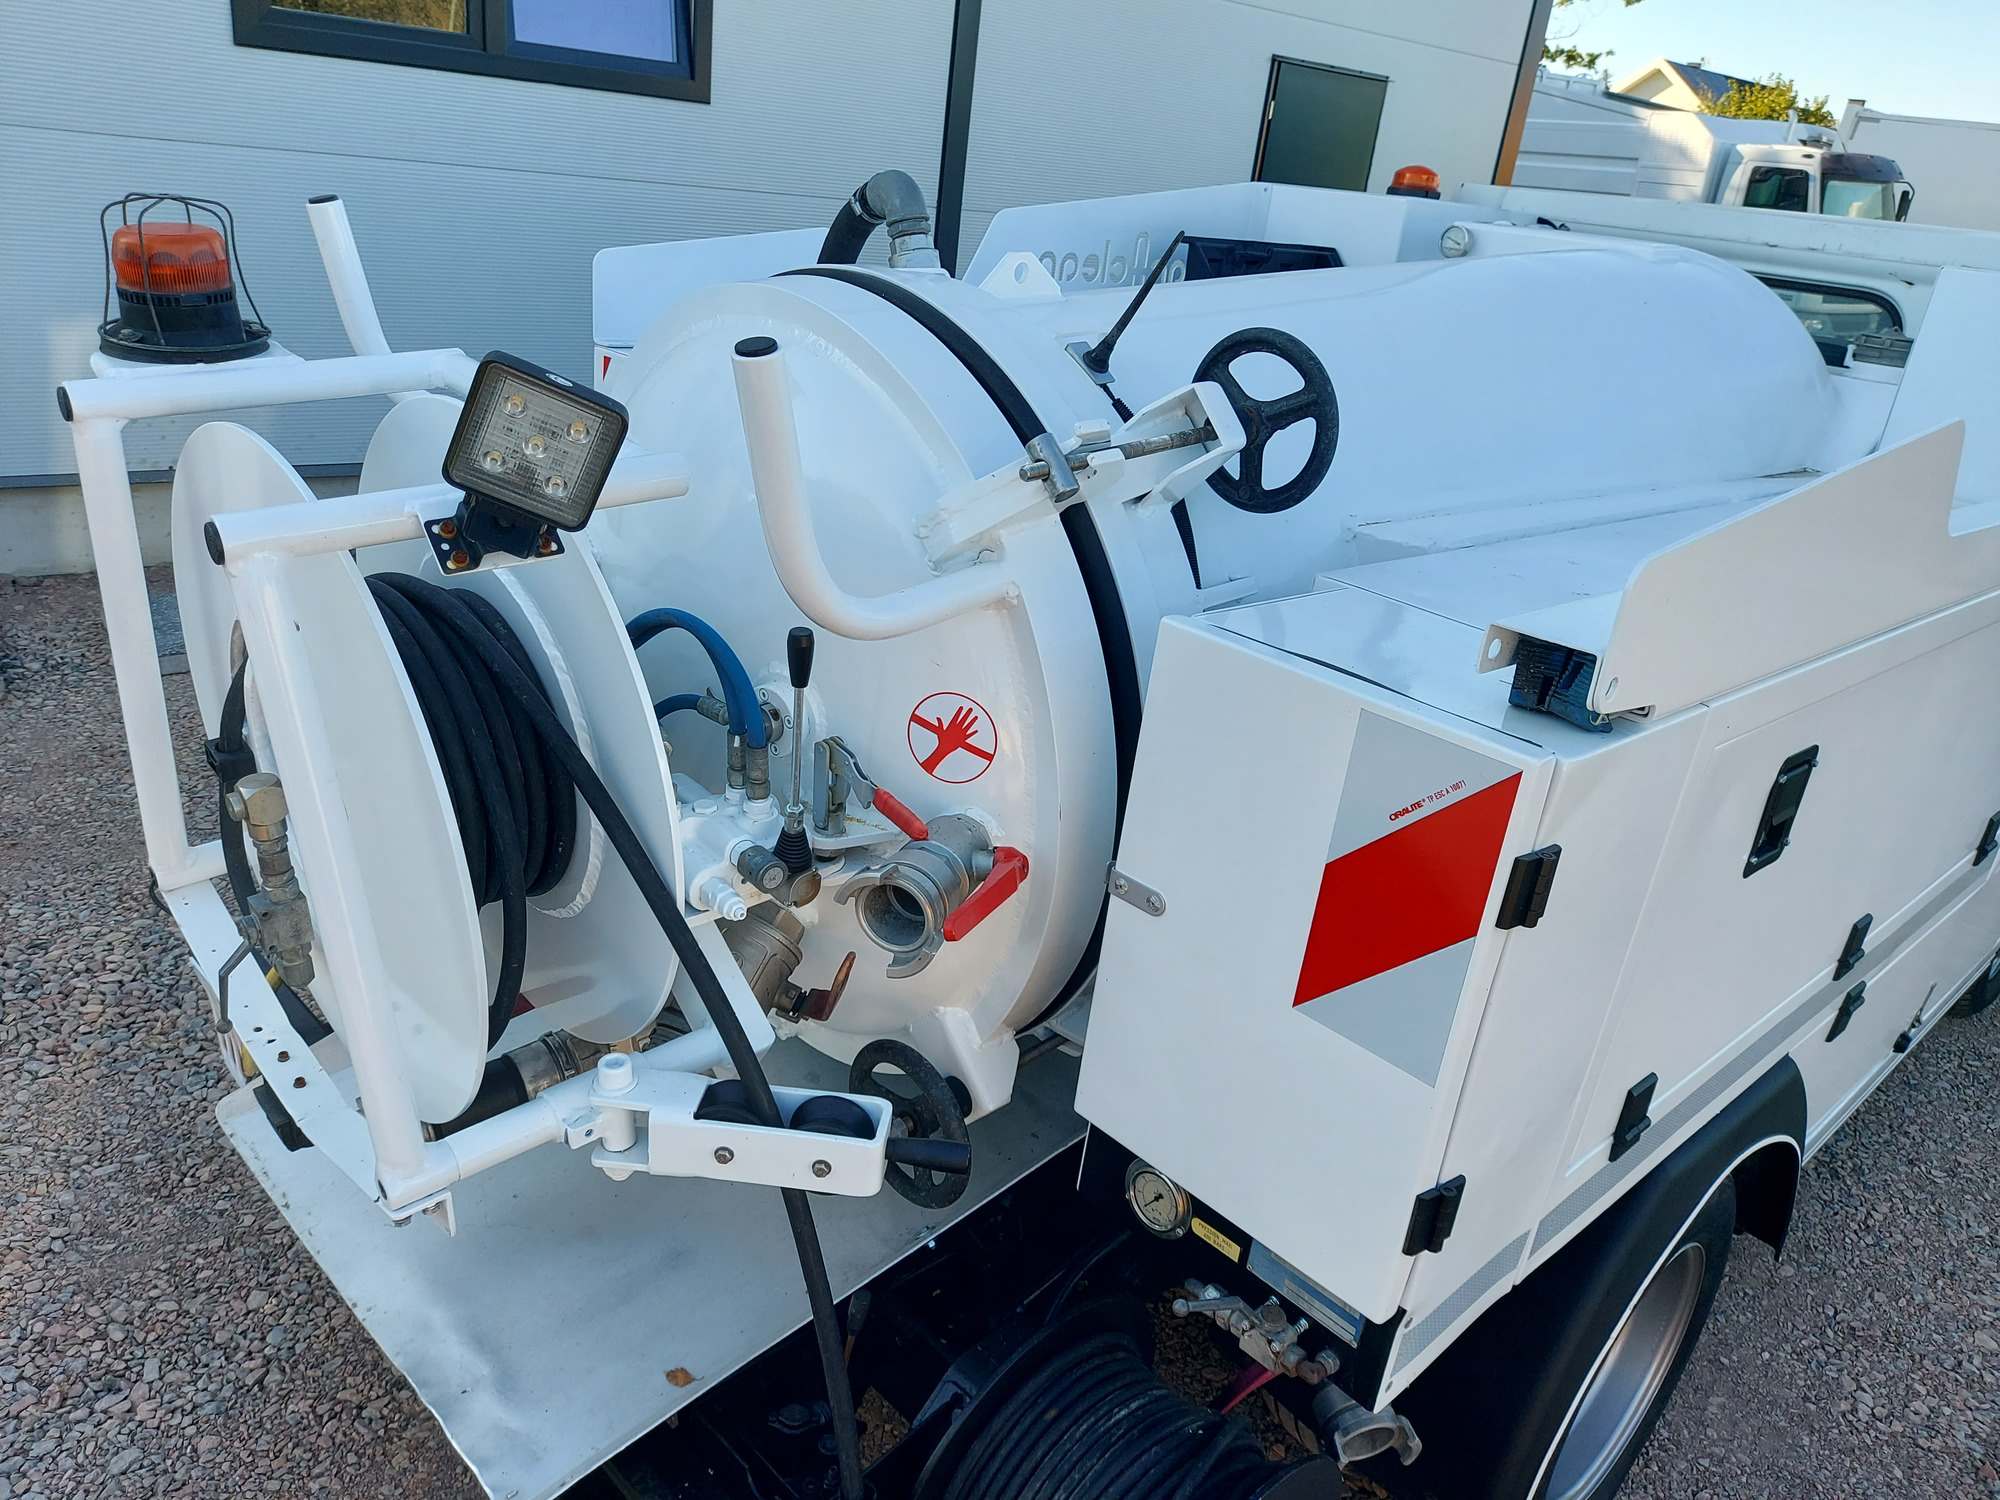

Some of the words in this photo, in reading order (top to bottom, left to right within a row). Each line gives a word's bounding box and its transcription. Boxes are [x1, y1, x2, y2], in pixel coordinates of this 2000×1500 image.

[1426, 794, 1434, 804] TP
[1434, 789, 1446, 800] ESC
[1445, 787, 1451, 795] A
